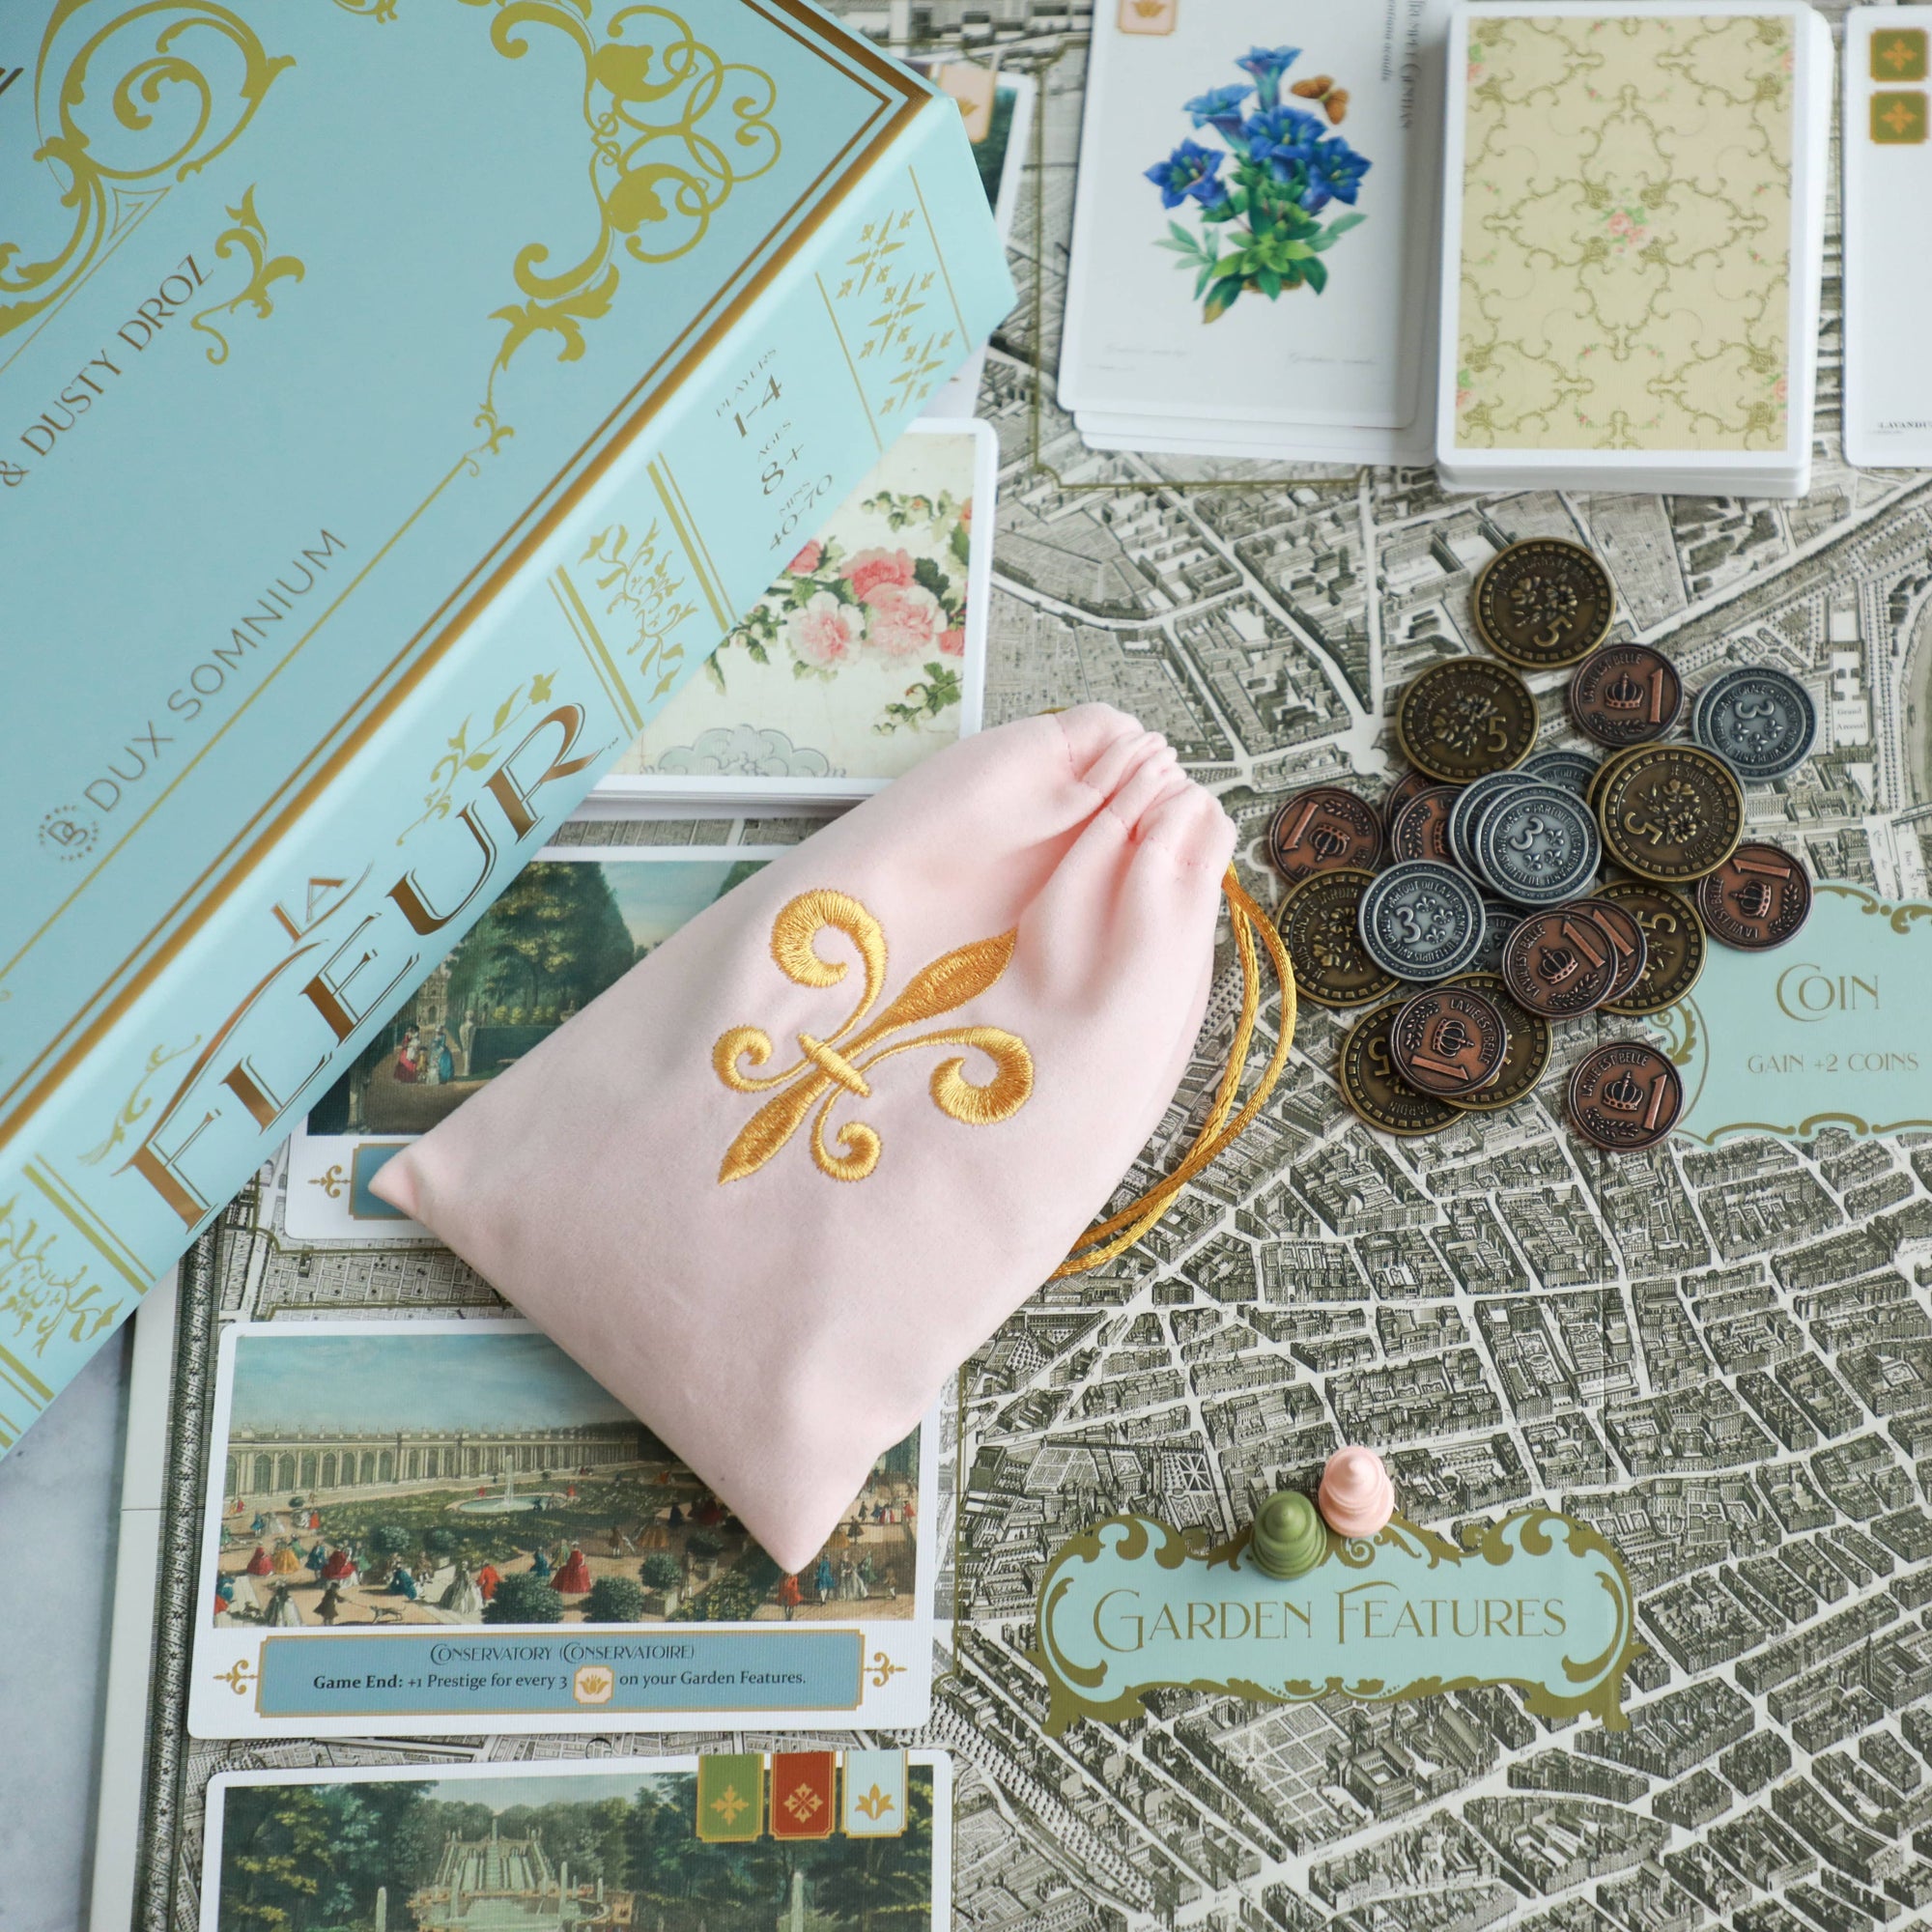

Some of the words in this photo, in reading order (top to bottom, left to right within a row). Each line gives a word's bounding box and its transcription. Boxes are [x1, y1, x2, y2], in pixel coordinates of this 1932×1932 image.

[1385, 0, 1397, 40] entiana
[20, 349, 122, 456] DUSTY
[117, 254, 214, 352] DROZ
[716, 349, 777, 417] PLAYERS
[1877, 420, 1932, 429] LAVANDU
[757, 421, 792, 463] AGES
[761, 443, 804, 495] 8+
[779, 482, 811, 518] MINS
[1533, 615, 1573, 646] 5
[83, 720, 176, 811] DUX
[167, 528, 347, 721] SOMNIUM
[1611, 652, 1643, 666] BELLE
[1650, 668, 1663, 724] 1
[1735, 699, 1775, 720] 3
[1488, 716, 1508, 752] 5
[1282, 800, 1320, 851] 1
[1510, 816, 1544, 850] 3
[1624, 811, 1662, 844] 5
[1732, 859, 1791, 879] 1
[270, 859, 374, 949] LA
[1396, 907, 1421, 944] 3
[1518, 923, 1547, 950] BELLE
[1594, 909, 1634, 956] 1
[1636, 911, 1677, 934] 5
[1513, 949, 1528, 966] EST
[1562, 921, 1605, 967] 1
[111, 702, 605, 1235] FLEUR
[1514, 970, 1531, 986] VIE
[1450, 998, 1465, 1010] LA
[1521, 981, 1540, 1000] LA
[1776, 963, 1880, 1022] COIN
[1463, 1002, 1482, 1018] VIE
[1476, 1014, 1493, 1033] EST
[1368, 1037, 1390, 1076] 5
[1477, 1035, 1494, 1065] BELLE
[1596, 1053, 1617, 1071] EST
[1618, 1051, 1650, 1067] BELLE
[1747, 1053, 1804, 1073] GAIN
[1814, 1054, 1838, 1071] +2
[1848, 1053, 1919, 1071] COINS
[1410, 1054, 1468, 1081] 1
[1582, 1065, 1601, 1084] VIE
[1578, 1082, 1593, 1095] LA
[1644, 1074, 1667, 1130] 1
[1093, 1589, 1312, 1653] GARDEN
[1334, 1580, 1568, 1644] FEATURES
[430, 1643, 553, 1665] CONSERVATORY
[559, 1641, 695, 1663] (CONSERVATOIRE)
[313, 1675, 361, 1690] Game
[366, 1674, 403, 1689] End:
[408, 1678, 422, 1688] +1
[428, 1673, 487, 1690] Prestige
[491, 1672, 512, 1687] for
[515, 1676, 555, 1690] every
[558, 1676, 568, 1690] 3
[619, 1675, 639, 1686] on
[643, 1675, 676, 1689] your
[680, 1670, 735, 1685] Garden
[740, 1670, 807, 1685] Features.
